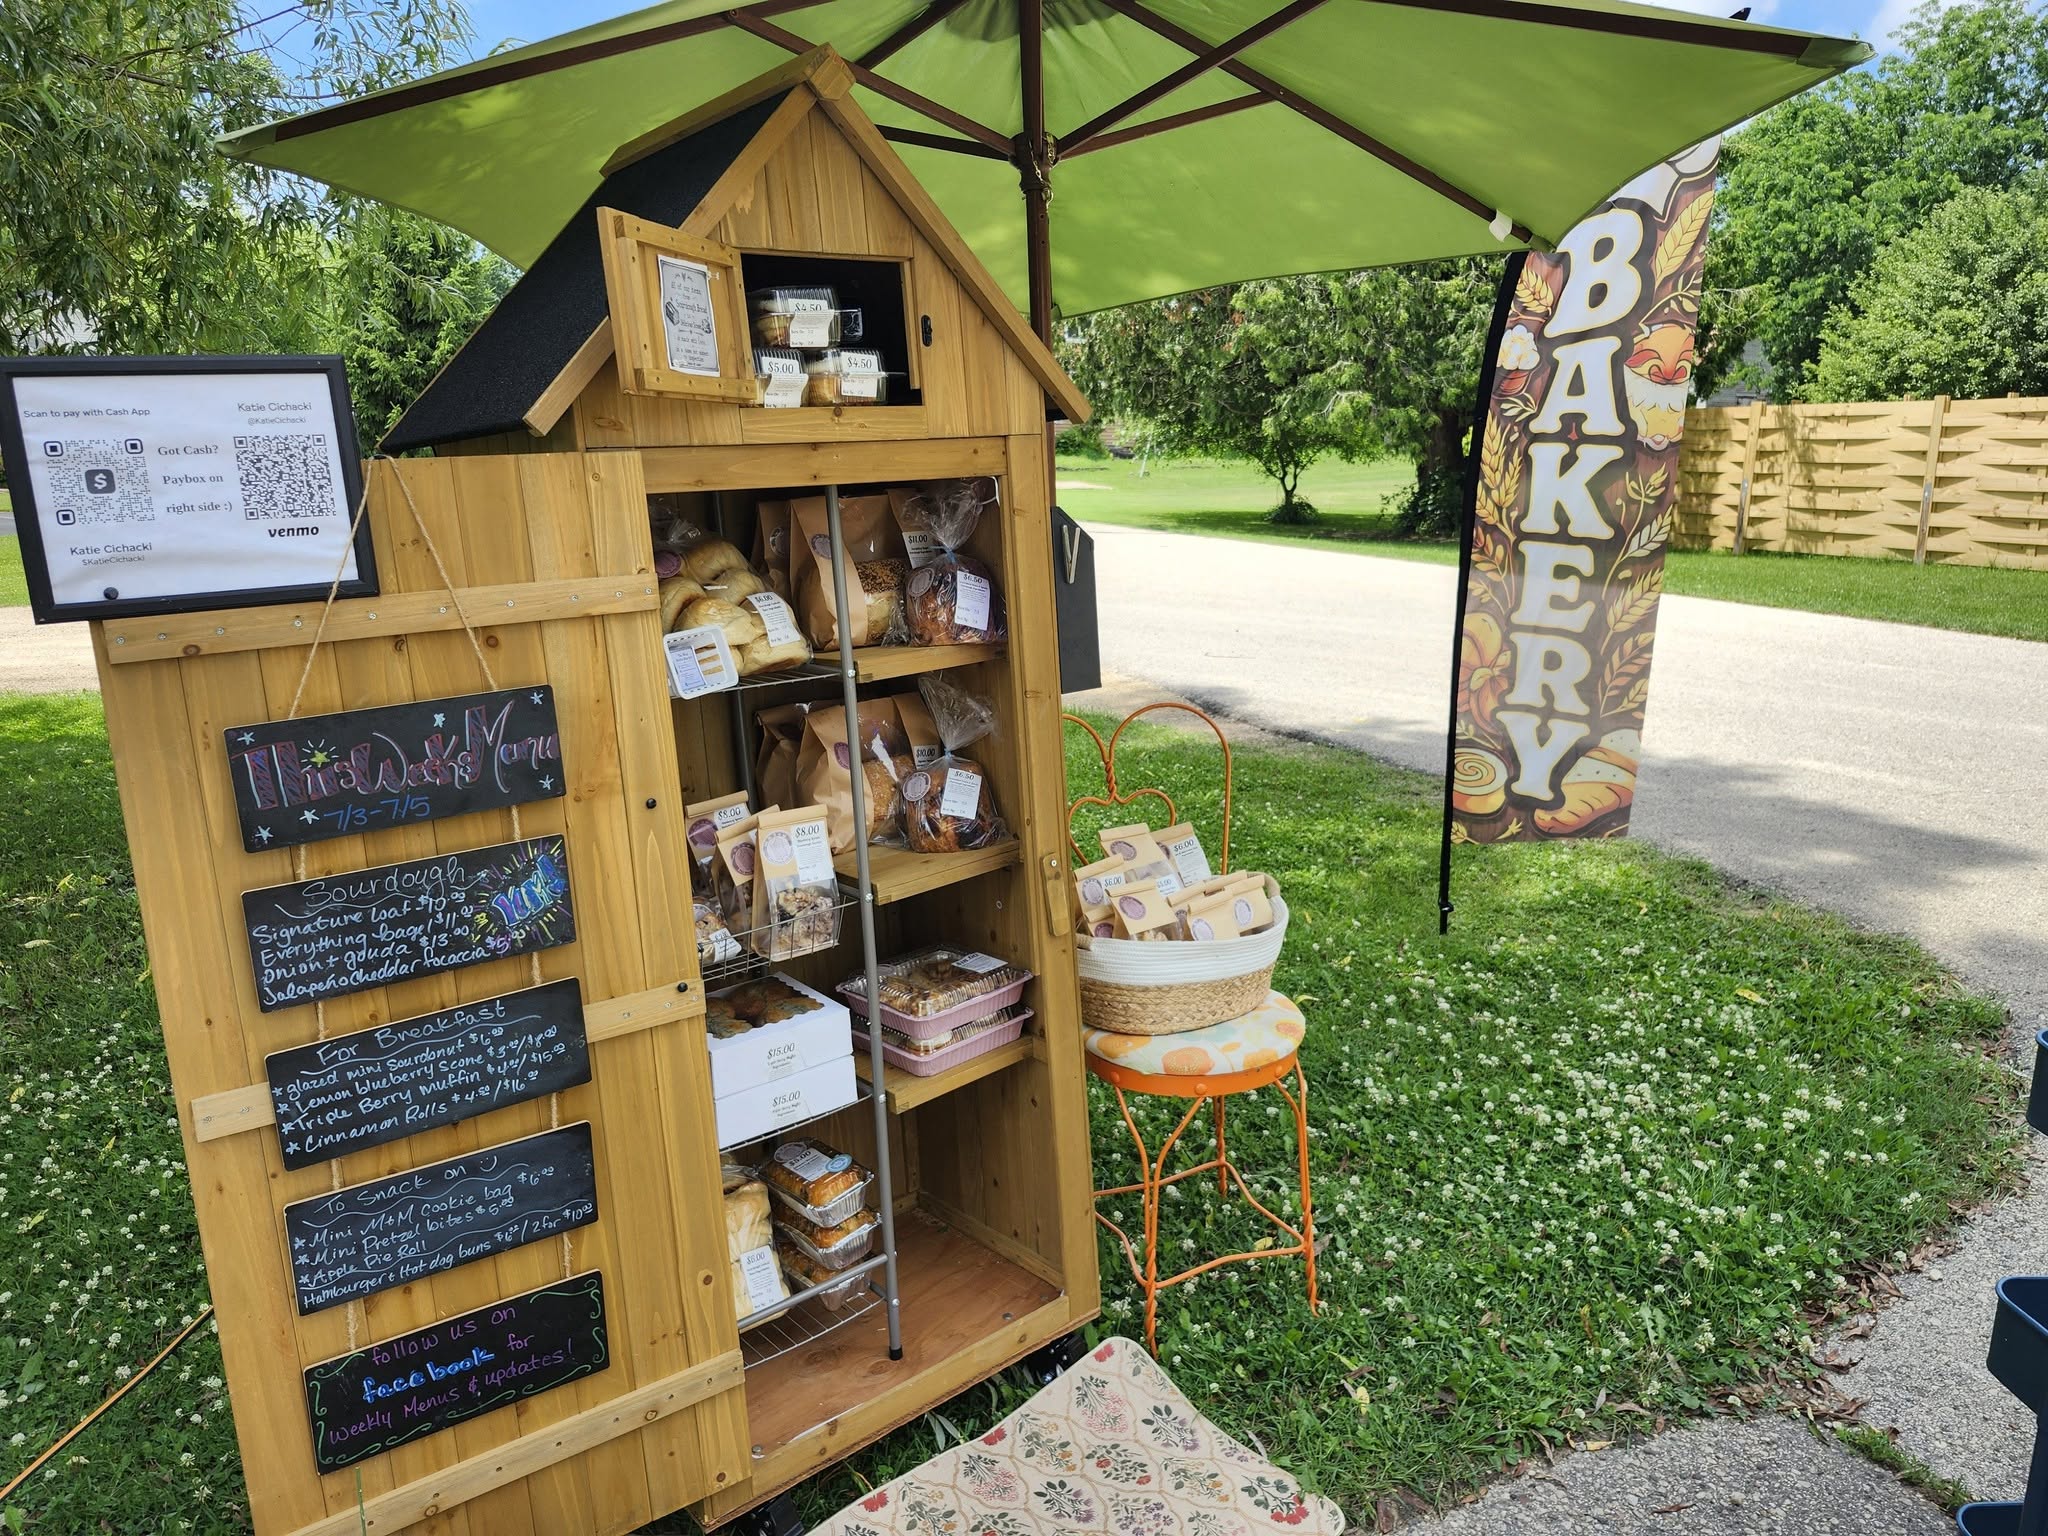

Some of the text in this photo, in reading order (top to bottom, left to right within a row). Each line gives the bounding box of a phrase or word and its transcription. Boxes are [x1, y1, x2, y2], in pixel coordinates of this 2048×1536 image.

[767, 361, 794, 374] $5.00
[847, 356, 873, 369] $4.50
[23, 407, 151, 418] Scan to pay with Cash App
[237, 402, 312, 412] Katie Cichacki
[157, 444, 219, 456] Got Cash?
[162, 473, 224, 487] Paybox on
[166, 501, 196, 515] right
[197, 501, 221, 512] side
[1496, 208, 1643, 801] BAKERY
[268, 525, 320, 538] venmo
[908, 534, 928, 545] $11.00
[70, 542, 153, 556] Katie Cichacki
[82, 555, 145, 567] $KatieCichacki
[230, 740, 356, 811] This
[465, 700, 561, 794] Menu
[717, 807, 741, 821] $8.00
[795, 824, 820, 838] $8.00
[1173, 838, 1195, 853] $6.00
[302, 856, 465, 907] Sourdough
[1104, 875, 1122, 888] $6.00
[252, 911, 363, 948] Signature
[260, 933, 368, 967] Everything
[344, 942, 412, 970] gouda
[423, 946, 491, 968] focaccia
[316, 1000, 505, 1066] For Breakfast
[347, 1062, 382, 1080] mini
[468, 1026, 504, 1046] $6.00
[767, 1042, 795, 1060] $15.00
[295, 1088, 353, 1114] Lemon
[355, 1063, 434, 1095] blueberry
[772, 1090, 801, 1108] $15.00
[293, 1108, 352, 1131] Triple
[358, 1089, 412, 1115] Berry
[305, 1116, 399, 1153] Cinnamon
[405, 1102, 448, 1124] Rolls
[314, 1165, 467, 1214] To Snack on
[309, 1225, 353, 1248] Mini
[516, 1165, 555, 1186] $6.00
[310, 1196, 515, 1266] Mini Pretzel bites $5.00
[308, 1239, 426, 1288] Apple Pie Roll
[429, 1253, 455, 1270] dog
[458, 1240, 492, 1259] buns
[450, 1320, 478, 1340] us
[491, 1307, 516, 1325] on
[507, 1333, 535, 1351] for
[403, 1387, 461, 1418] Menus
